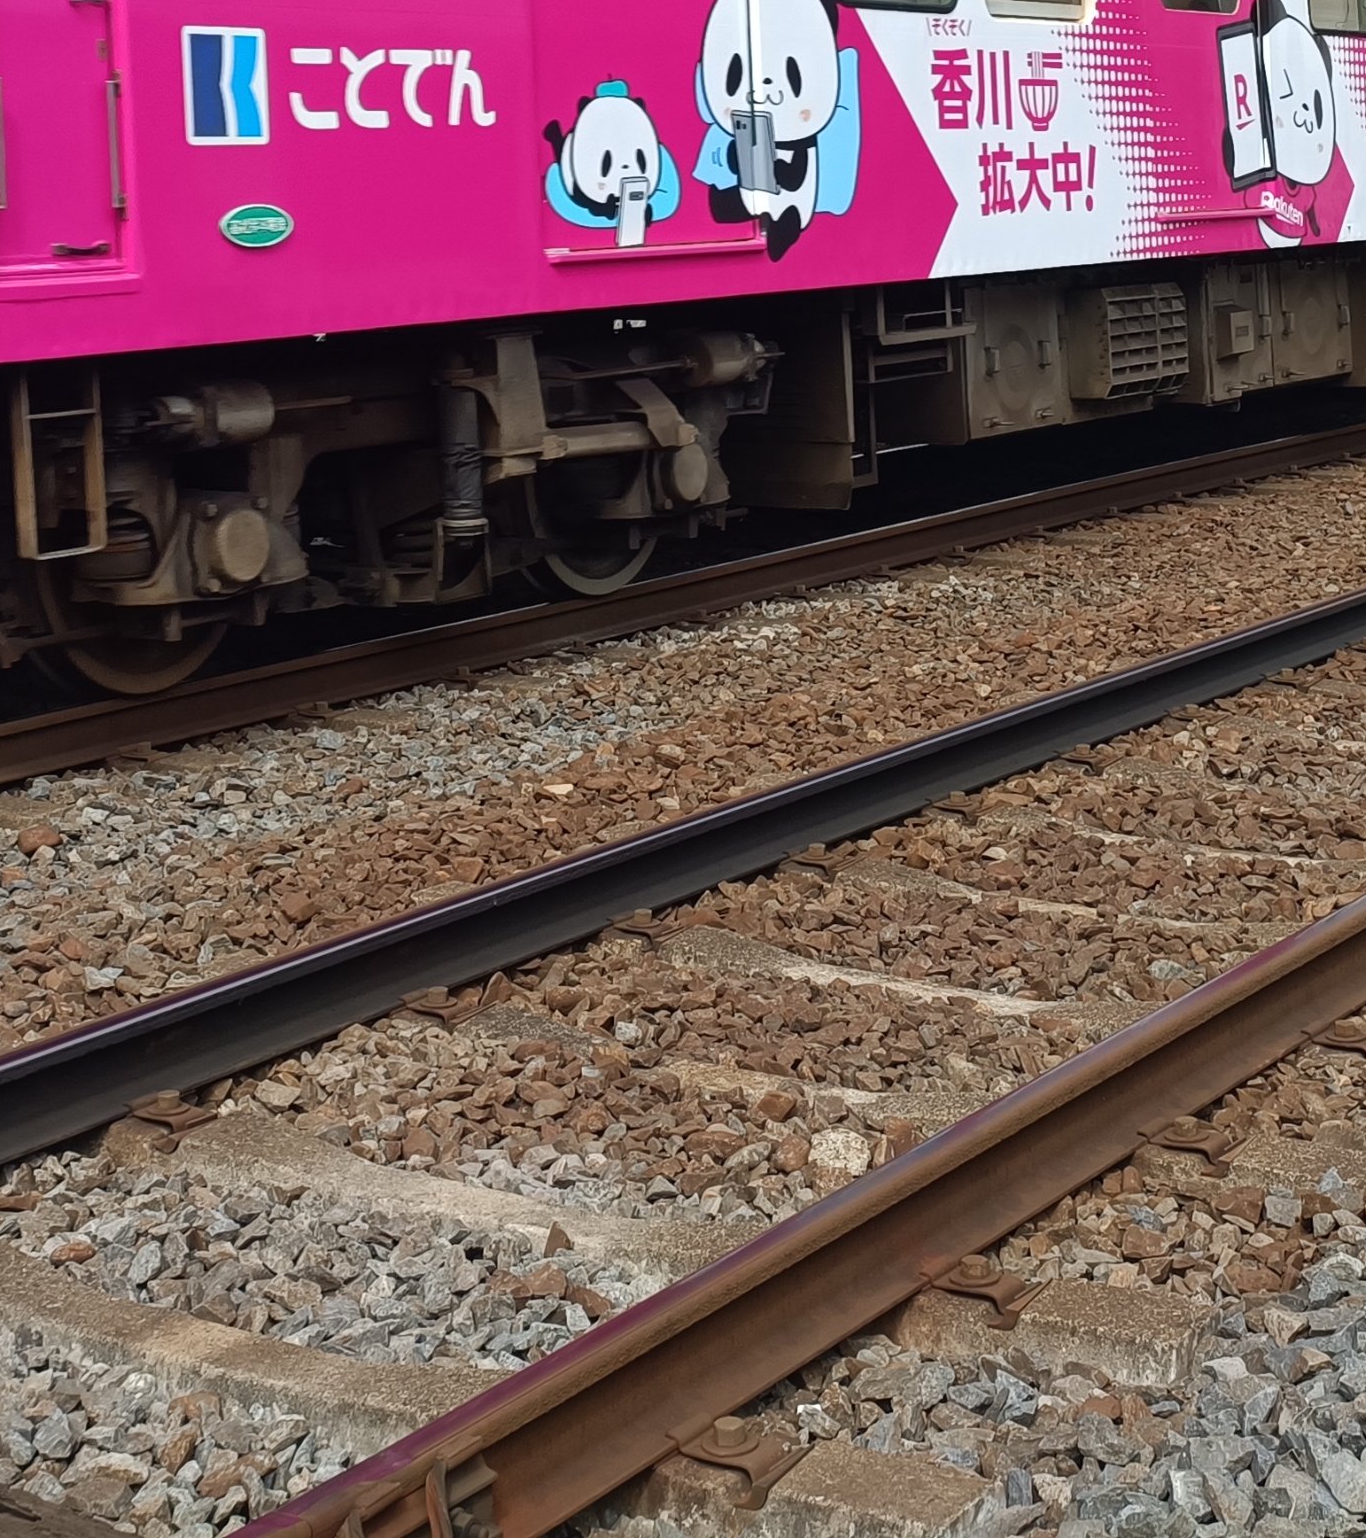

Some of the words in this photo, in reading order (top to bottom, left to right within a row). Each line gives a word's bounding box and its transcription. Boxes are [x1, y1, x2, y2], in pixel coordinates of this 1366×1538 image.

[289, 46, 496, 129] ことでん
[931, 48, 1013, 130] 香川
[978, 141, 1097, 217] 拡大中!
[1261, 191, 1303, 227] Rakuten
